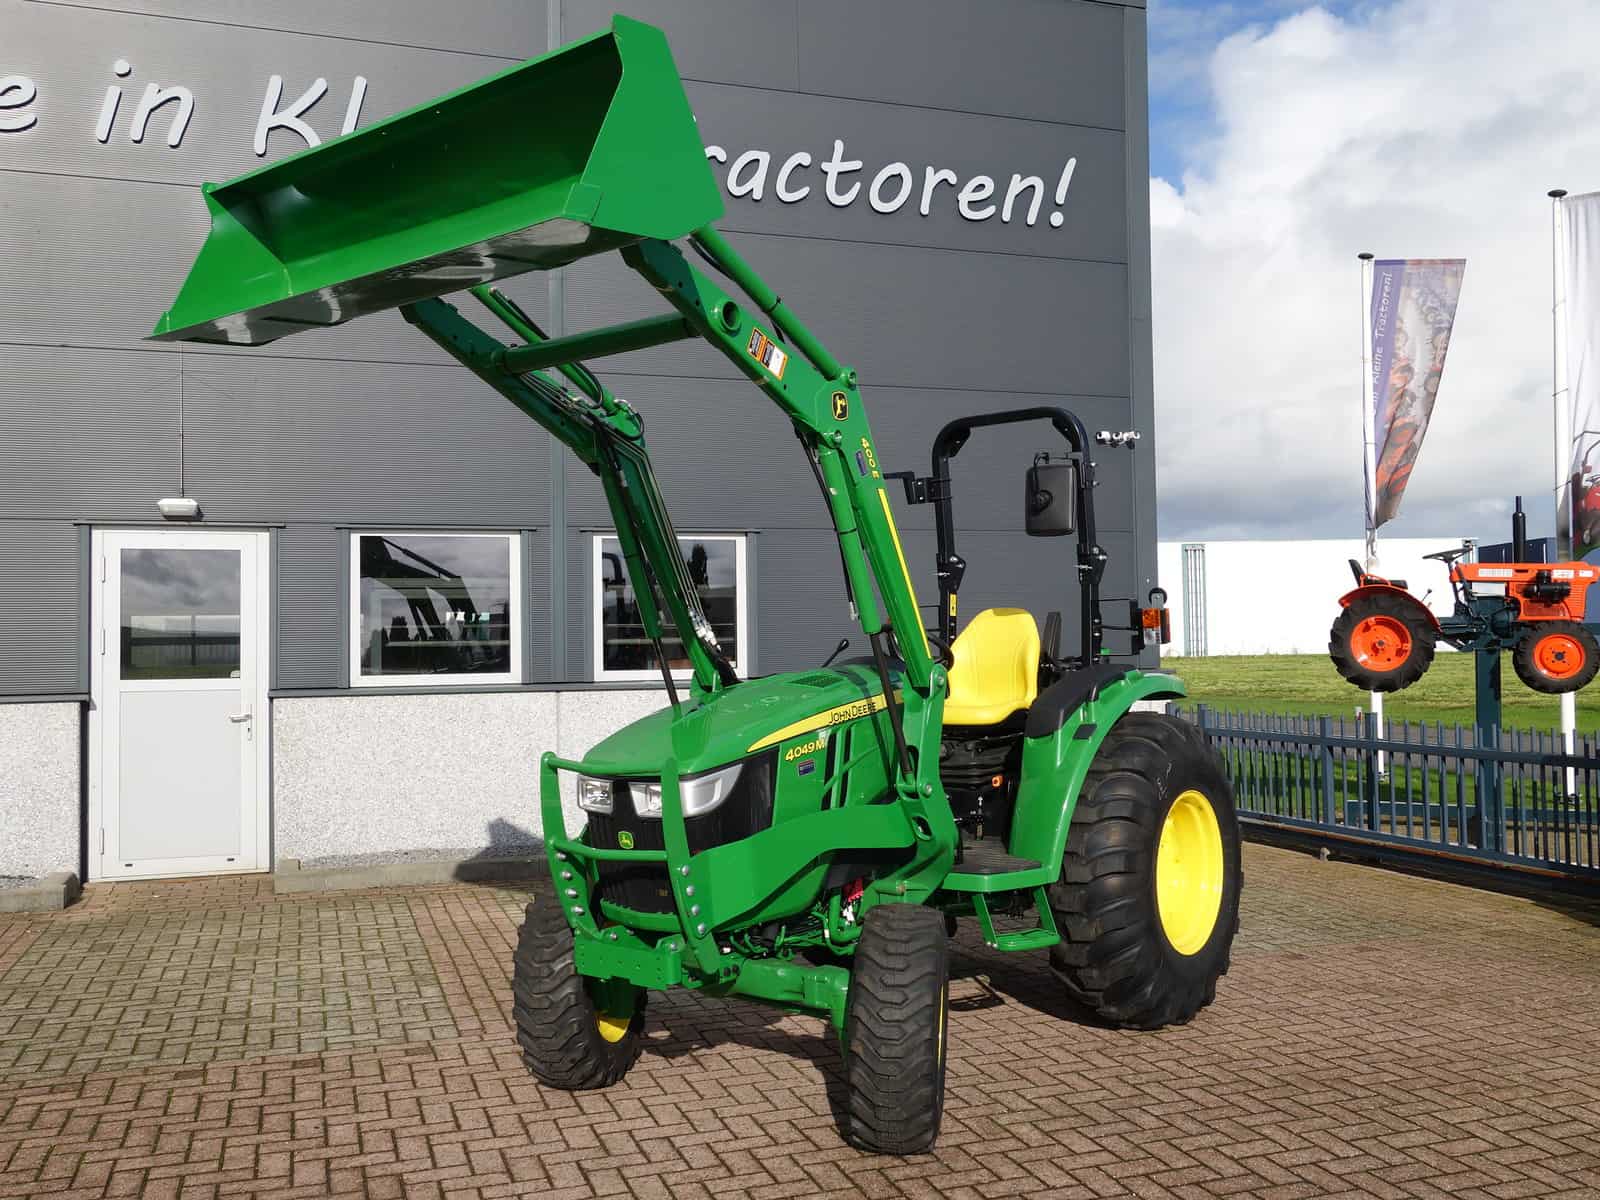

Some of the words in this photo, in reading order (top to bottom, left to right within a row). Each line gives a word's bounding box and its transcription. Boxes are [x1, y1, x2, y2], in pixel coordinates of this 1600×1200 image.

[95, 59, 195, 149] in
[829, 707, 851, 723] JOHN
[852, 702, 876, 716] DEERE
[785, 739, 825, 761] 4049M
